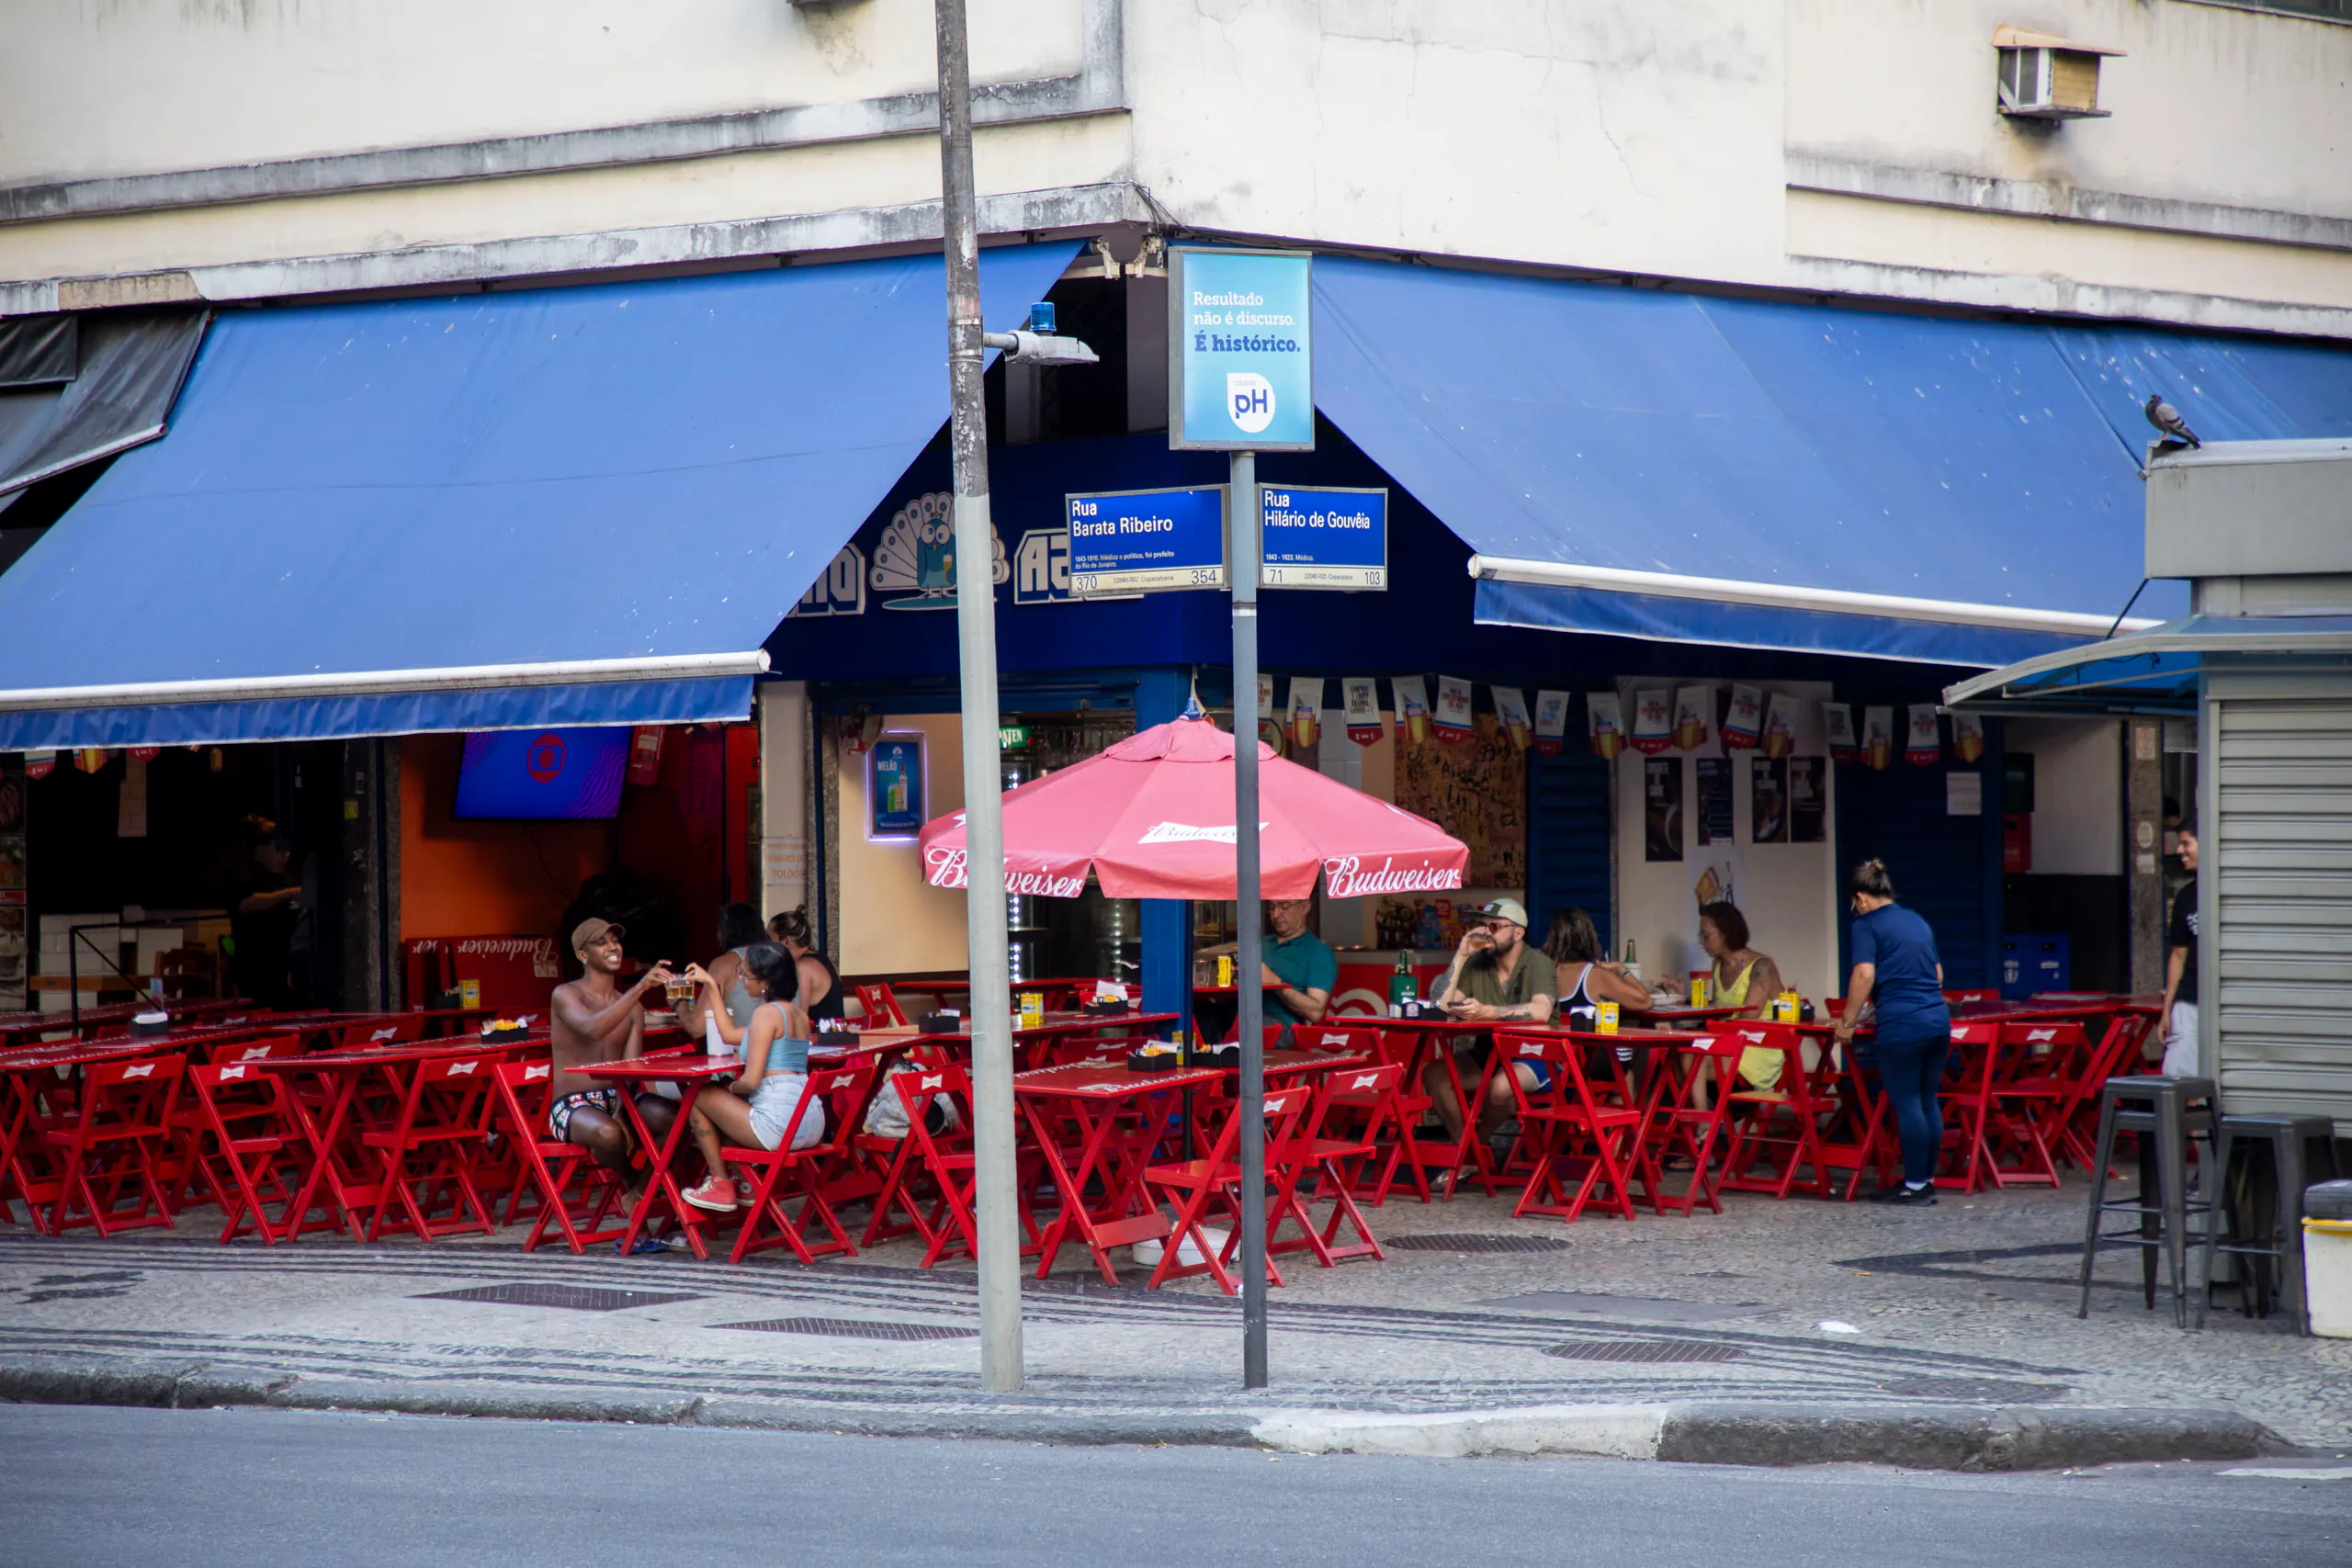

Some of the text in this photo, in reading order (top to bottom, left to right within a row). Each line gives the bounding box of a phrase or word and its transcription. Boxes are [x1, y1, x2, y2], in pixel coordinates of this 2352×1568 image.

[1193, 291, 1263, 306] Resultado
[1193, 310, 1296, 325] não é discurso.
[1194, 329, 1301, 353] É histórico.
[1235, 389, 1268, 419] pH
[1264, 490, 1290, 507] Rua
[1072, 500, 1097, 517] Rua
[1073, 515, 1173, 537] Barata Ribeiro
[1264, 510, 1370, 529] Hilário de Gouvêia
[1153, 550, 1175, 559] prefeito
[1076, 575, 1098, 591] 370
[1191, 570, 1217, 585] 354
[1270, 569, 1283, 583] 71
[1364, 571, 1381, 585] 103
[1325, 856, 1460, 897] Budweiser
